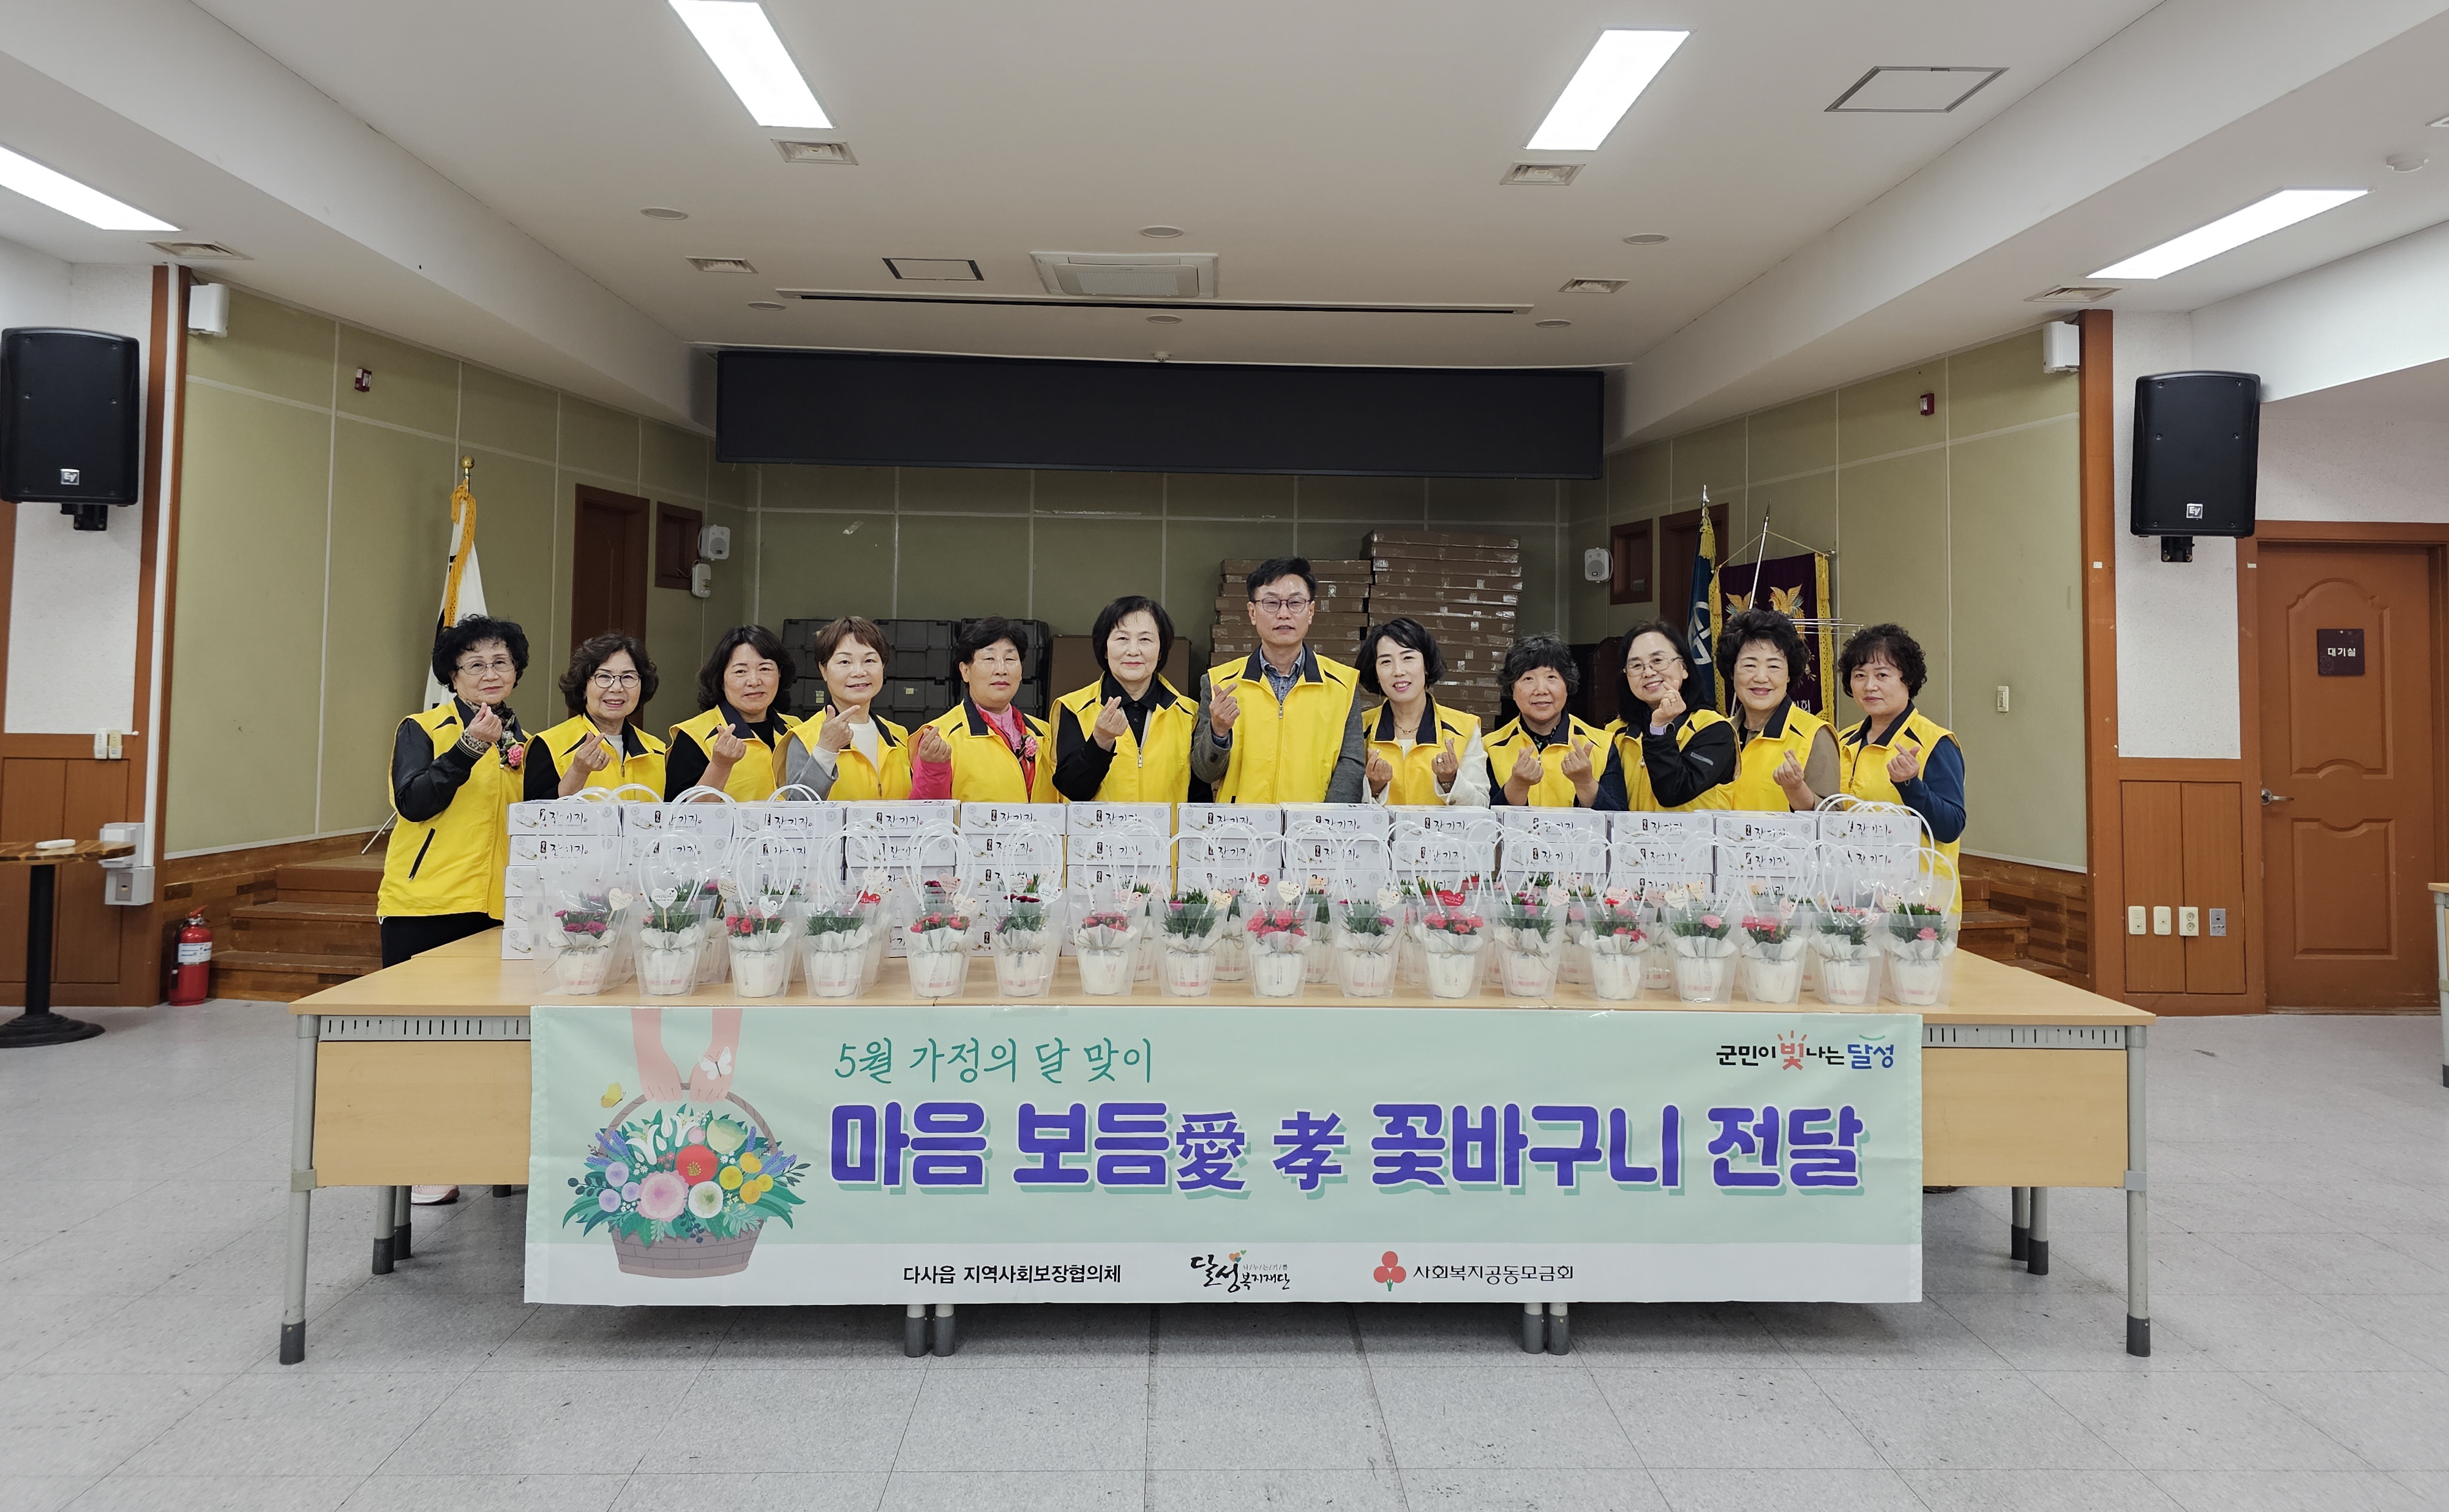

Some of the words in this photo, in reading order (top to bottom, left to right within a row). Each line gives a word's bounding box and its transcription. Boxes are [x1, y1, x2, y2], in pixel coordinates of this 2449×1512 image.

[2189, 506, 2200, 516] EV
[2327, 648, 2356, 657] 대기실
[834, 1037, 892, 1084] 5월
[910, 1038, 1017, 1083] 가정의
[1036, 1037, 1071, 1084] 달
[1084, 1037, 1151, 1083] 맞이
[1716, 1046, 1776, 1066] 군민이
[1848, 1044, 1894, 1069] 달성
[831, 1102, 987, 1186] 마음
[1273, 1112, 1345, 1191] 孝
[1372, 1104, 1679, 1187] 꽃바구니
[1708, 1105, 1864, 1187] 전달
[904, 1265, 956, 1284] 다사읍
[963, 1264, 1122, 1284] 지역사회보장협의체
[1190, 1254, 1241, 1293] 달성
[1240, 1272, 1291, 1290] 복지재단
[1412, 1265, 1573, 1286] 사회복지공동모금회
